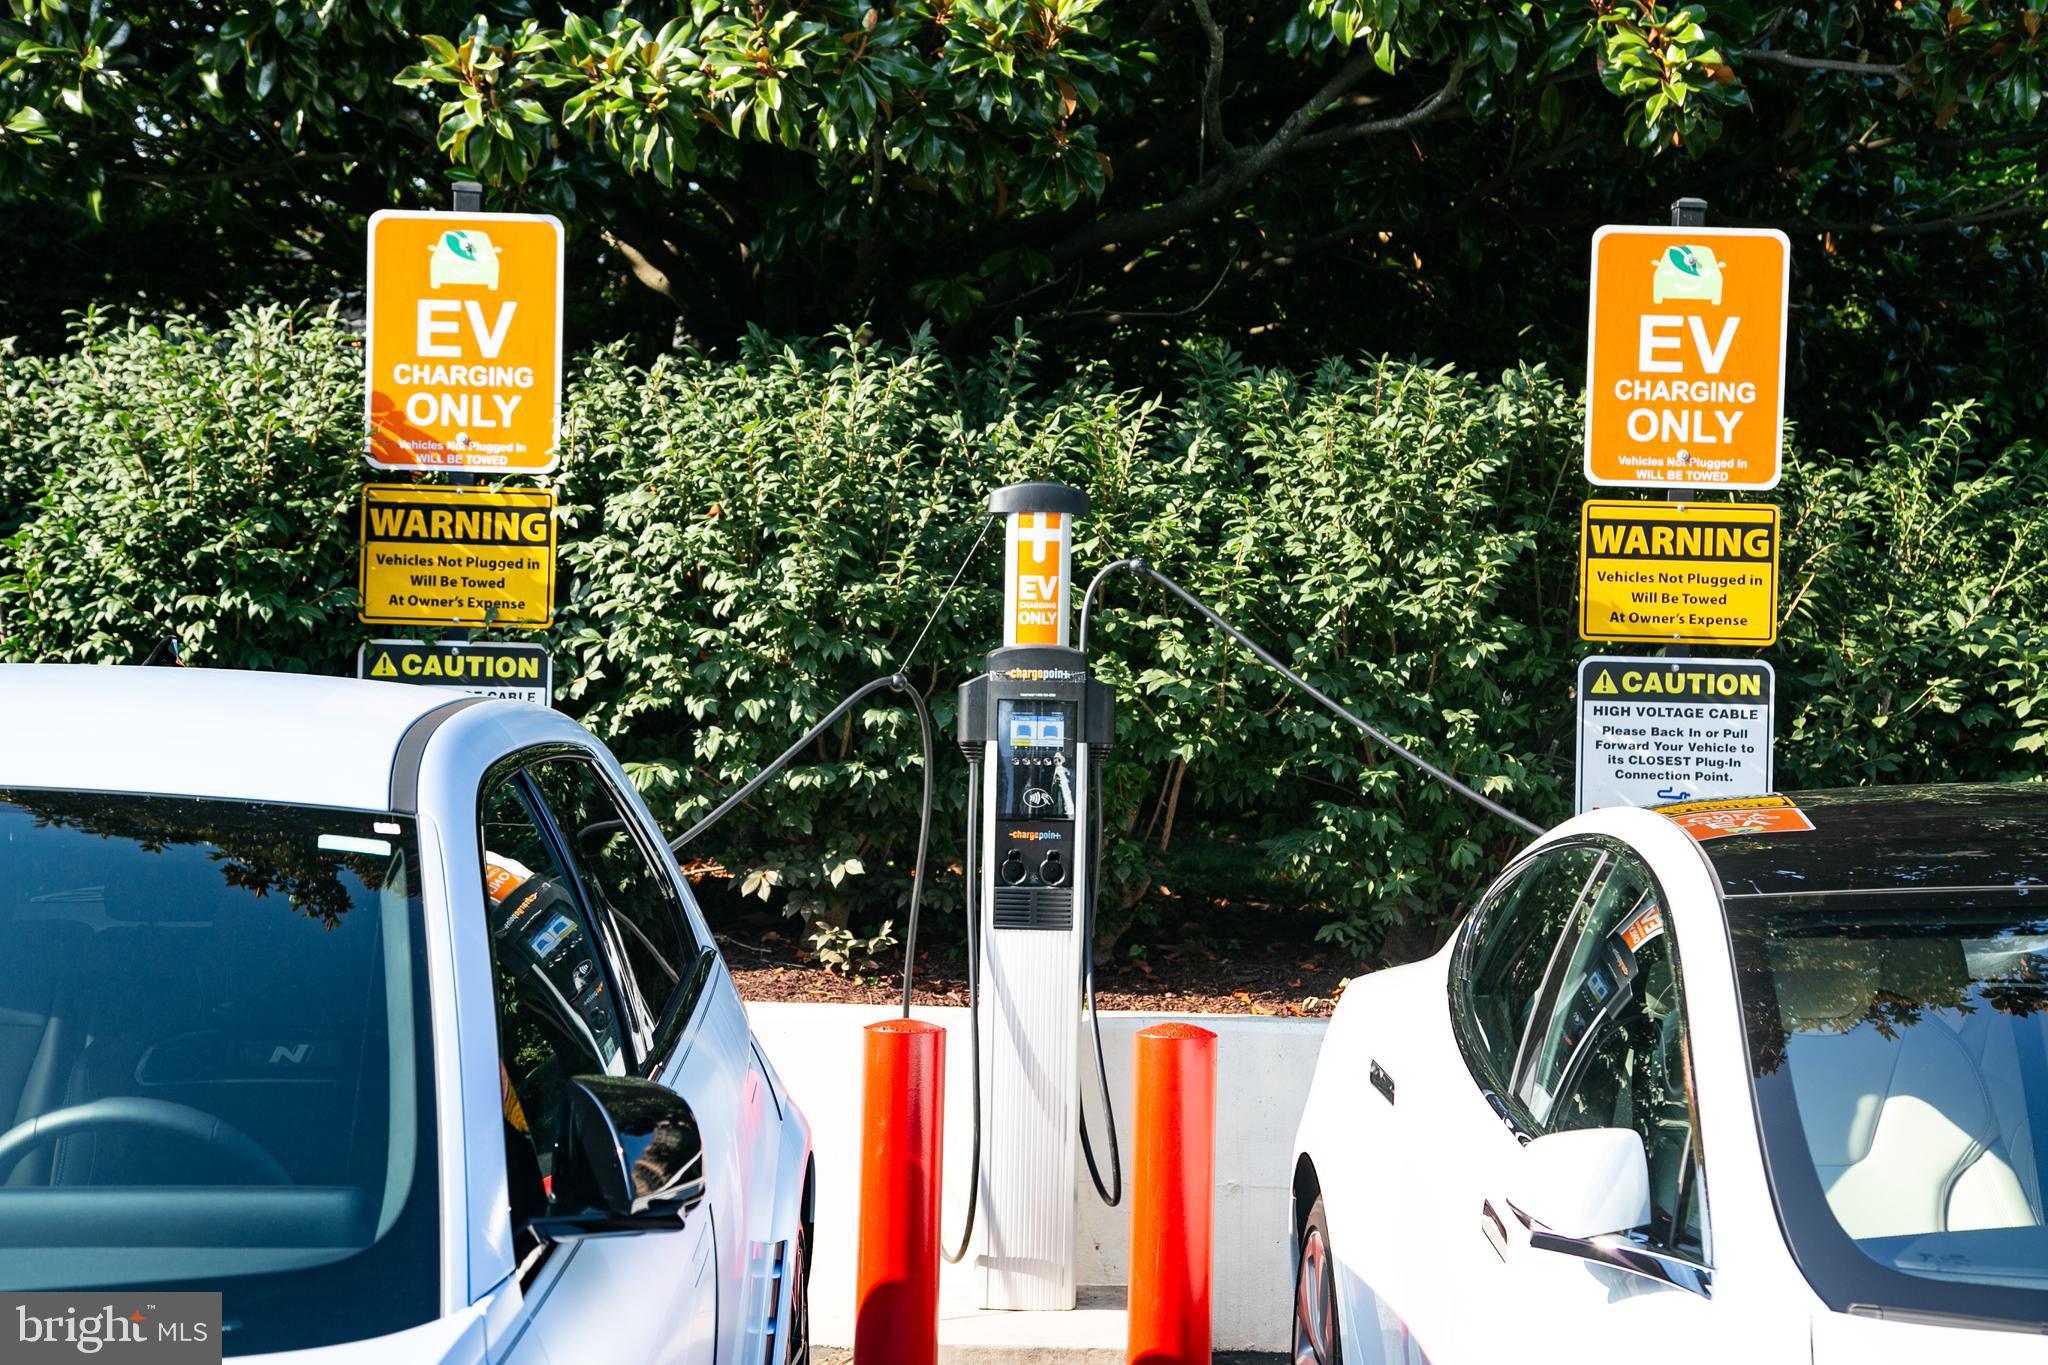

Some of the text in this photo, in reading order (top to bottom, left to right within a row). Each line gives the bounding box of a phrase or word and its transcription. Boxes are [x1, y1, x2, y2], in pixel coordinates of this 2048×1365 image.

[416, 298, 518, 359] EV
[1638, 314, 1741, 374] EV
[393, 363, 534, 388] CHARGING
[1614, 379, 1757, 404] CHARGING
[406, 392, 522, 428] ONLY
[1626, 408, 1744, 444] ONLY
[398, 440, 443, 450] Vehicles
[468, 442, 514, 454] Plugged
[416, 453, 509, 465] WILL BE TOWED
[1617, 455, 1664, 467] Vehicles
[1688, 457, 1735, 470] Plugged
[1636, 469, 1729, 481] WILL BE TOWED
[369, 508, 548, 542] WARNING
[1590, 524, 1770, 558] WARNING
[375, 553, 541, 571] Vehicles Not Plugged in
[410, 574, 506, 589] Will Be Towed
[1019, 575, 1058, 600] EV
[1597, 571, 1763, 588] Vehicles Not Plugged in
[388, 594, 405, 606] At
[467, 597, 526, 611] Expense
[1631, 592, 1728, 605] Will Be Towed
[1018, 611, 1058, 625] ONLY
[1609, 611, 1625, 623] At
[1689, 613, 1748, 628] Expense
[401, 653, 539, 679] CAUTION
[1621, 670, 1761, 697] CAUTION
[1593, 705, 1759, 720] HIGH VOLTAGE CABLE
[1602, 725, 1748, 739] Please Back In or Pull
[1595, 740, 1755, 753] Forward Your Vehicle to
[1608, 754, 1741, 769] its CLOSEST Plug-In
[1615, 769, 1734, 782] Connection Point.
